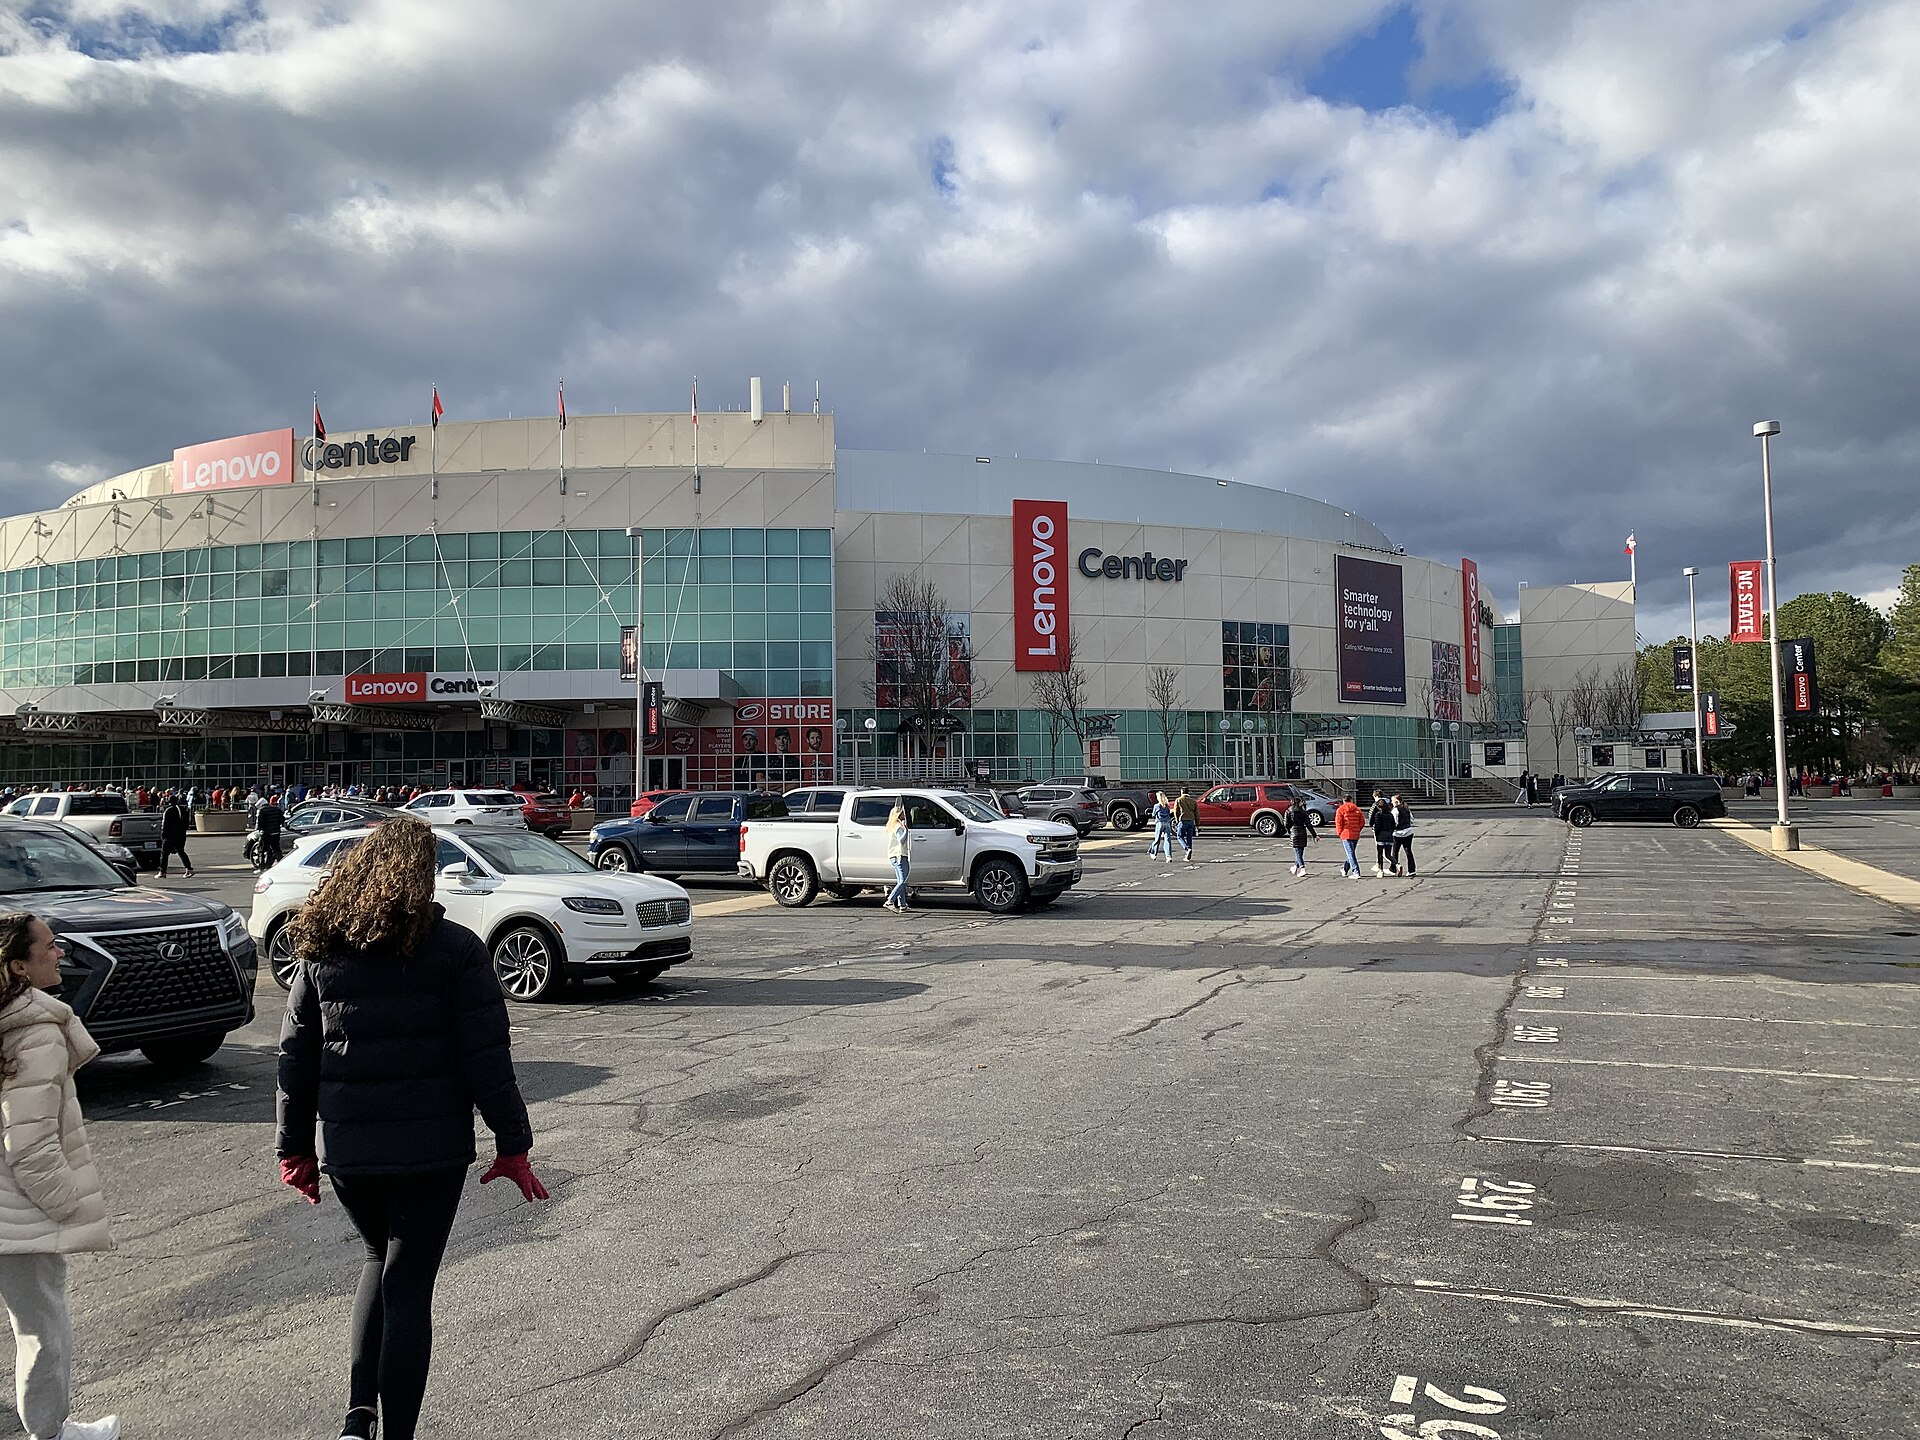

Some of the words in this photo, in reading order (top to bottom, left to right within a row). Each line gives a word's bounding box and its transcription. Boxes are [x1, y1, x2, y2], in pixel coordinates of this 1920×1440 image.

[182, 450, 281, 490] Lenovo
[301, 433, 416, 472] Center
[1078, 547, 1188, 582] Center
[1027, 515, 1057, 656] Lenovo
[1738, 570, 1753, 590] NC
[1343, 588, 1379, 604] Smarter
[1344, 602, 1393, 622] technology
[1344, 616, 1357, 629] for
[1359, 618, 1379, 632] y'all.
[1738, 593, 1754, 634] STATE
[1469, 572, 1479, 681] Lenovo
[1794, 644, 1804, 672] Center
[351, 680, 419, 696] Lenovo
[1798, 677, 1807, 708] Lenovo
[770, 704, 831, 719] STORE
[1513, 1025, 1560, 1043] 289
[1490, 1079, 1552, 1107] 290
[1451, 1177, 1537, 1226] 291
